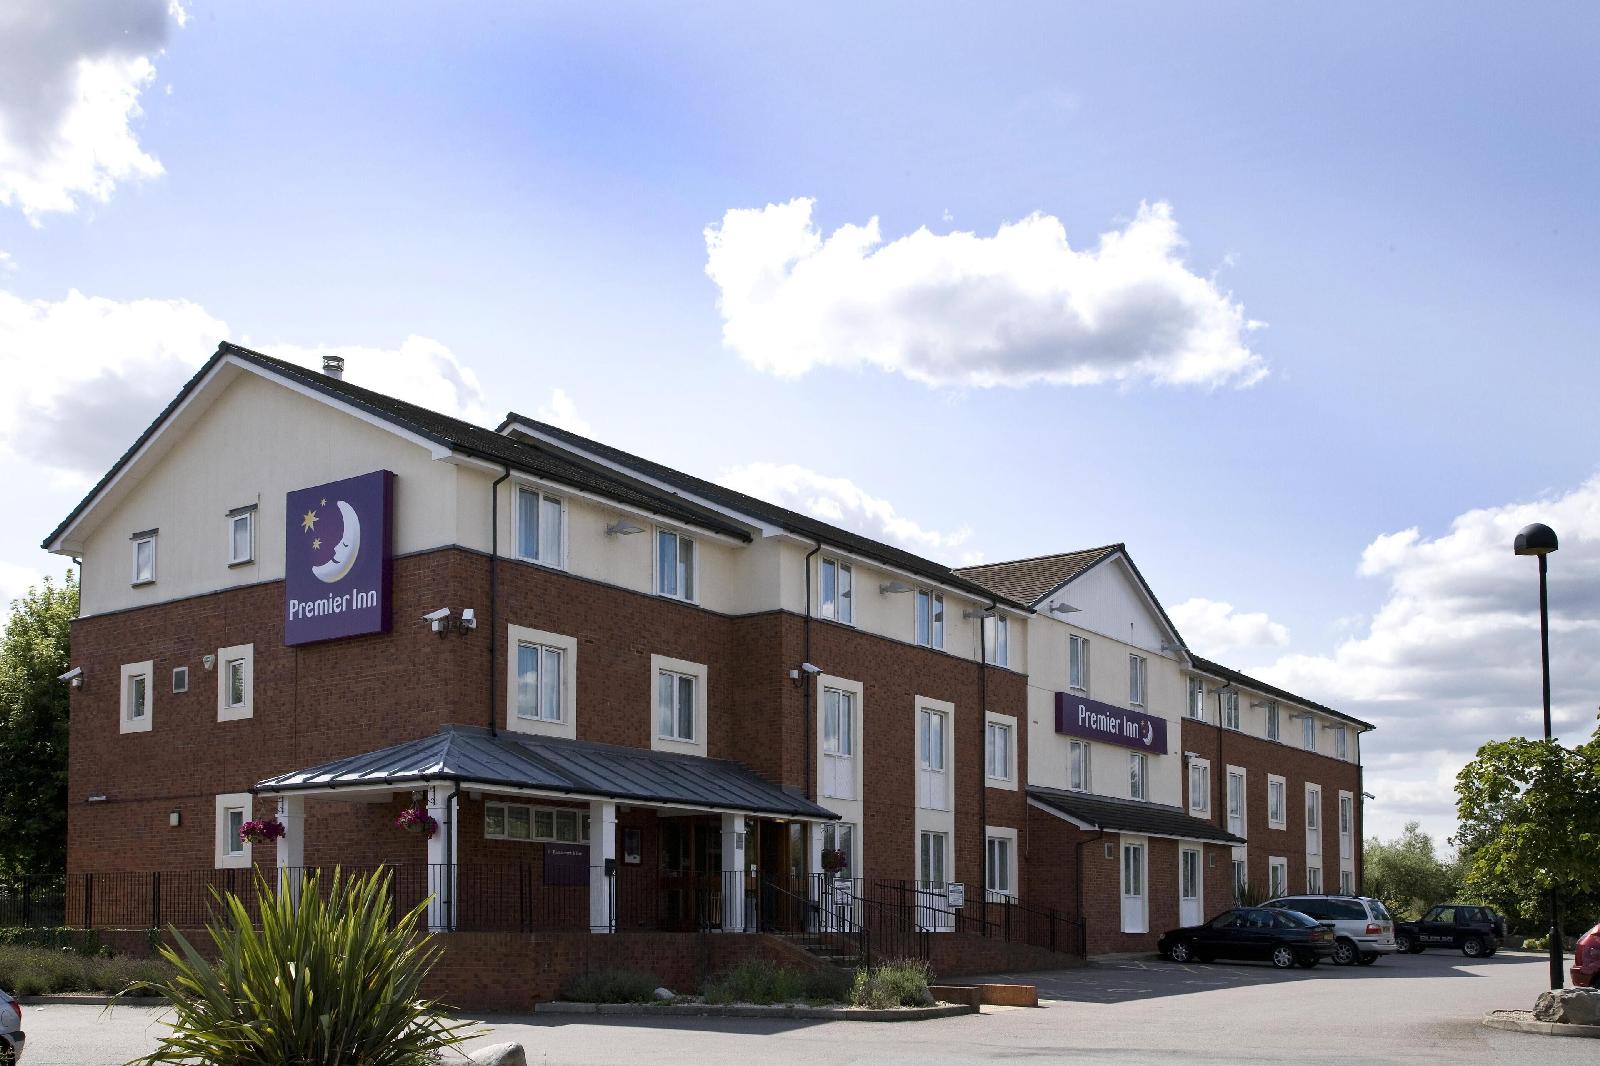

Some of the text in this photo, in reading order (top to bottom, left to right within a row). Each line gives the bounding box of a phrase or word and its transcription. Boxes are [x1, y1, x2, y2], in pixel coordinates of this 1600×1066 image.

[289, 588, 377, 620] Premier Inn
[1078, 704, 1139, 739] Premier Inn
